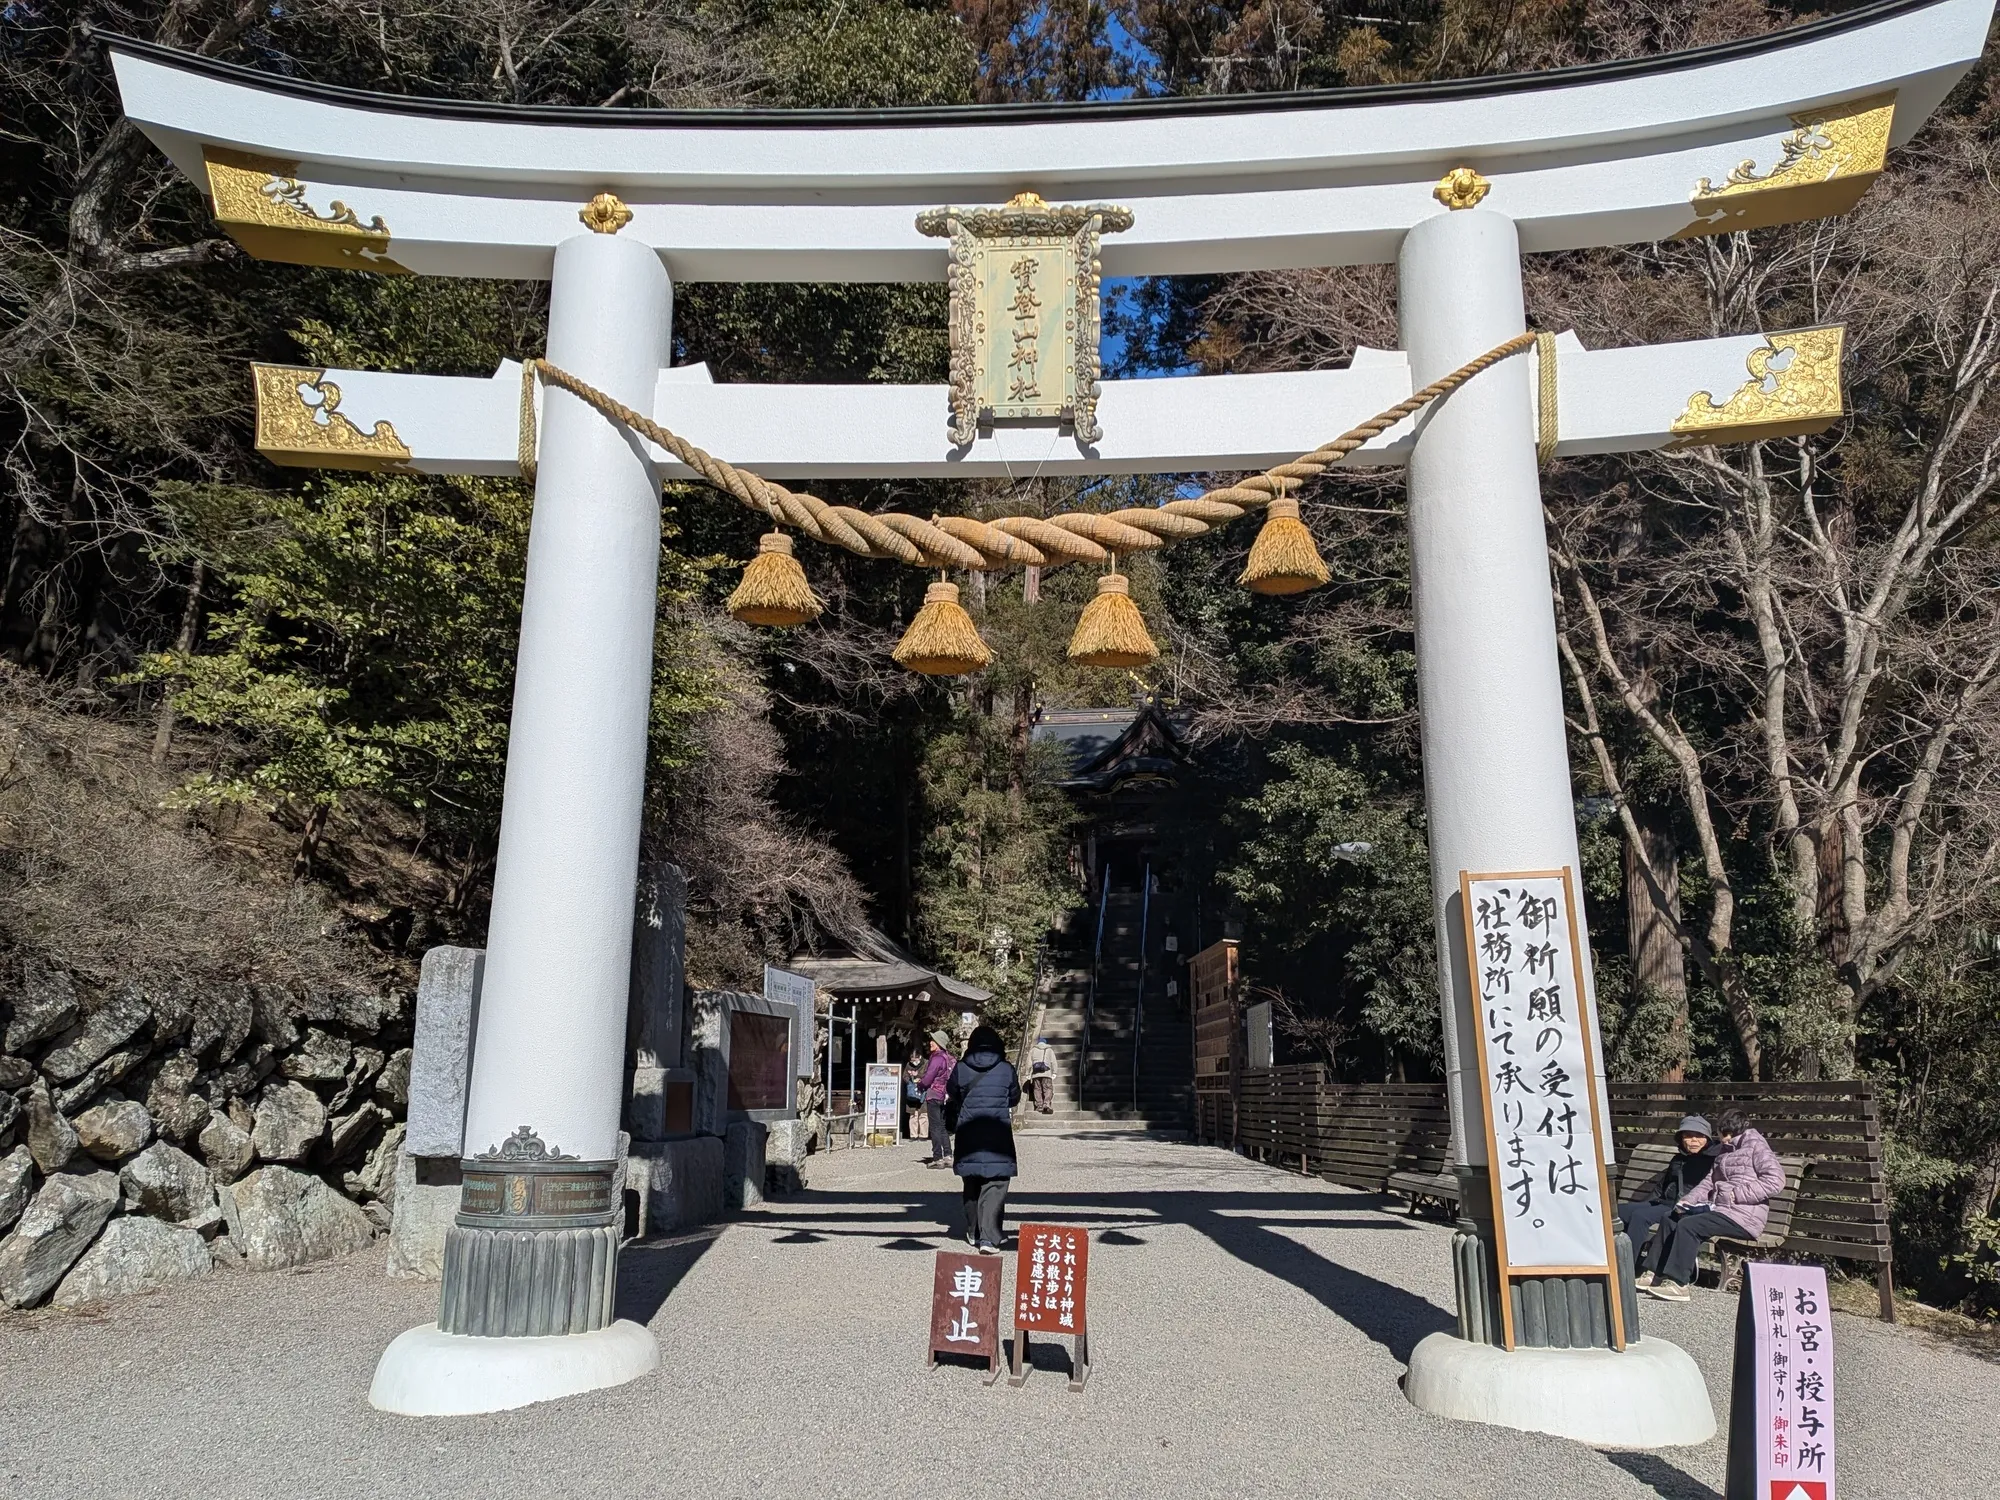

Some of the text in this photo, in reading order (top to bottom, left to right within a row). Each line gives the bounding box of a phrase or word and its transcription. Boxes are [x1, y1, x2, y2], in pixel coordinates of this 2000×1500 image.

[1476, 888, 1545, 1229] 「社務所」にて承ります。
[1517, 888, 1593, 1214] 御祈願の受付は、
[946, 1265, 985, 1344] 車止
[1019, 1292, 1029, 1321] 社務所
[1029, 1233, 1046, 1323] ご遠慮下さい
[1045, 1234, 1062, 1311] 犬の散歩は
[1059, 1236, 1077, 1329] これより神域
[1794, 1287, 1826, 1474] お宮・授与所
